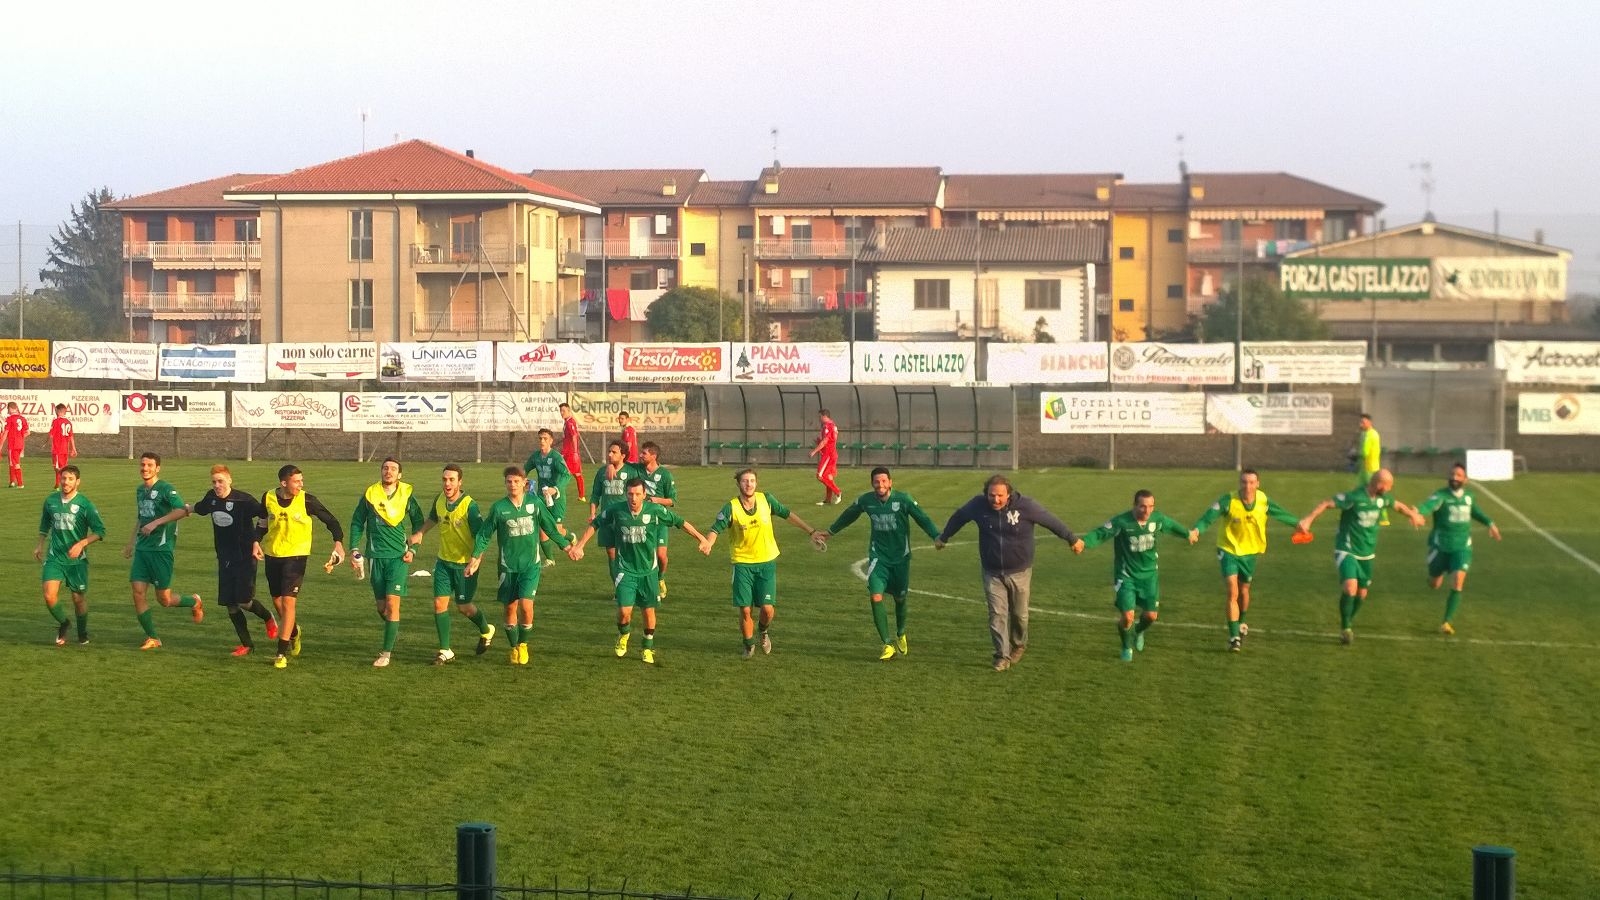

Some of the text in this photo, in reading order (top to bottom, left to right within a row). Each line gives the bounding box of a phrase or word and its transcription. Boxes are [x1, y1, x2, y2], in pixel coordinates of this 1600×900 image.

[1281, 265, 1430, 293] FORZA CASTELLAZZO
[282, 344, 376, 359] non solo carne
[412, 348, 477, 360] UNIMAG
[627, 347, 712, 370] Prestofresco
[751, 345, 800, 360] PIANA
[1, 360, 47, 375] COSMOGAS
[757, 362, 811, 374] LEGNAMI
[864, 353, 965, 373] U. S. CASTELLAZZO
[0, 402, 47, 416] PZZA
[525, 405, 559, 413] METALLICA
[571, 394, 665, 414] CENTROFRUTTA
[1071, 397, 1150, 408] Forniture
[583, 416, 671, 424] SCIRATI
[1070, 410, 1152, 420] UFFICIO
[1521, 408, 1552, 423] MB
[16, 418, 23, 431] 3
[60, 422, 72, 437] 10
